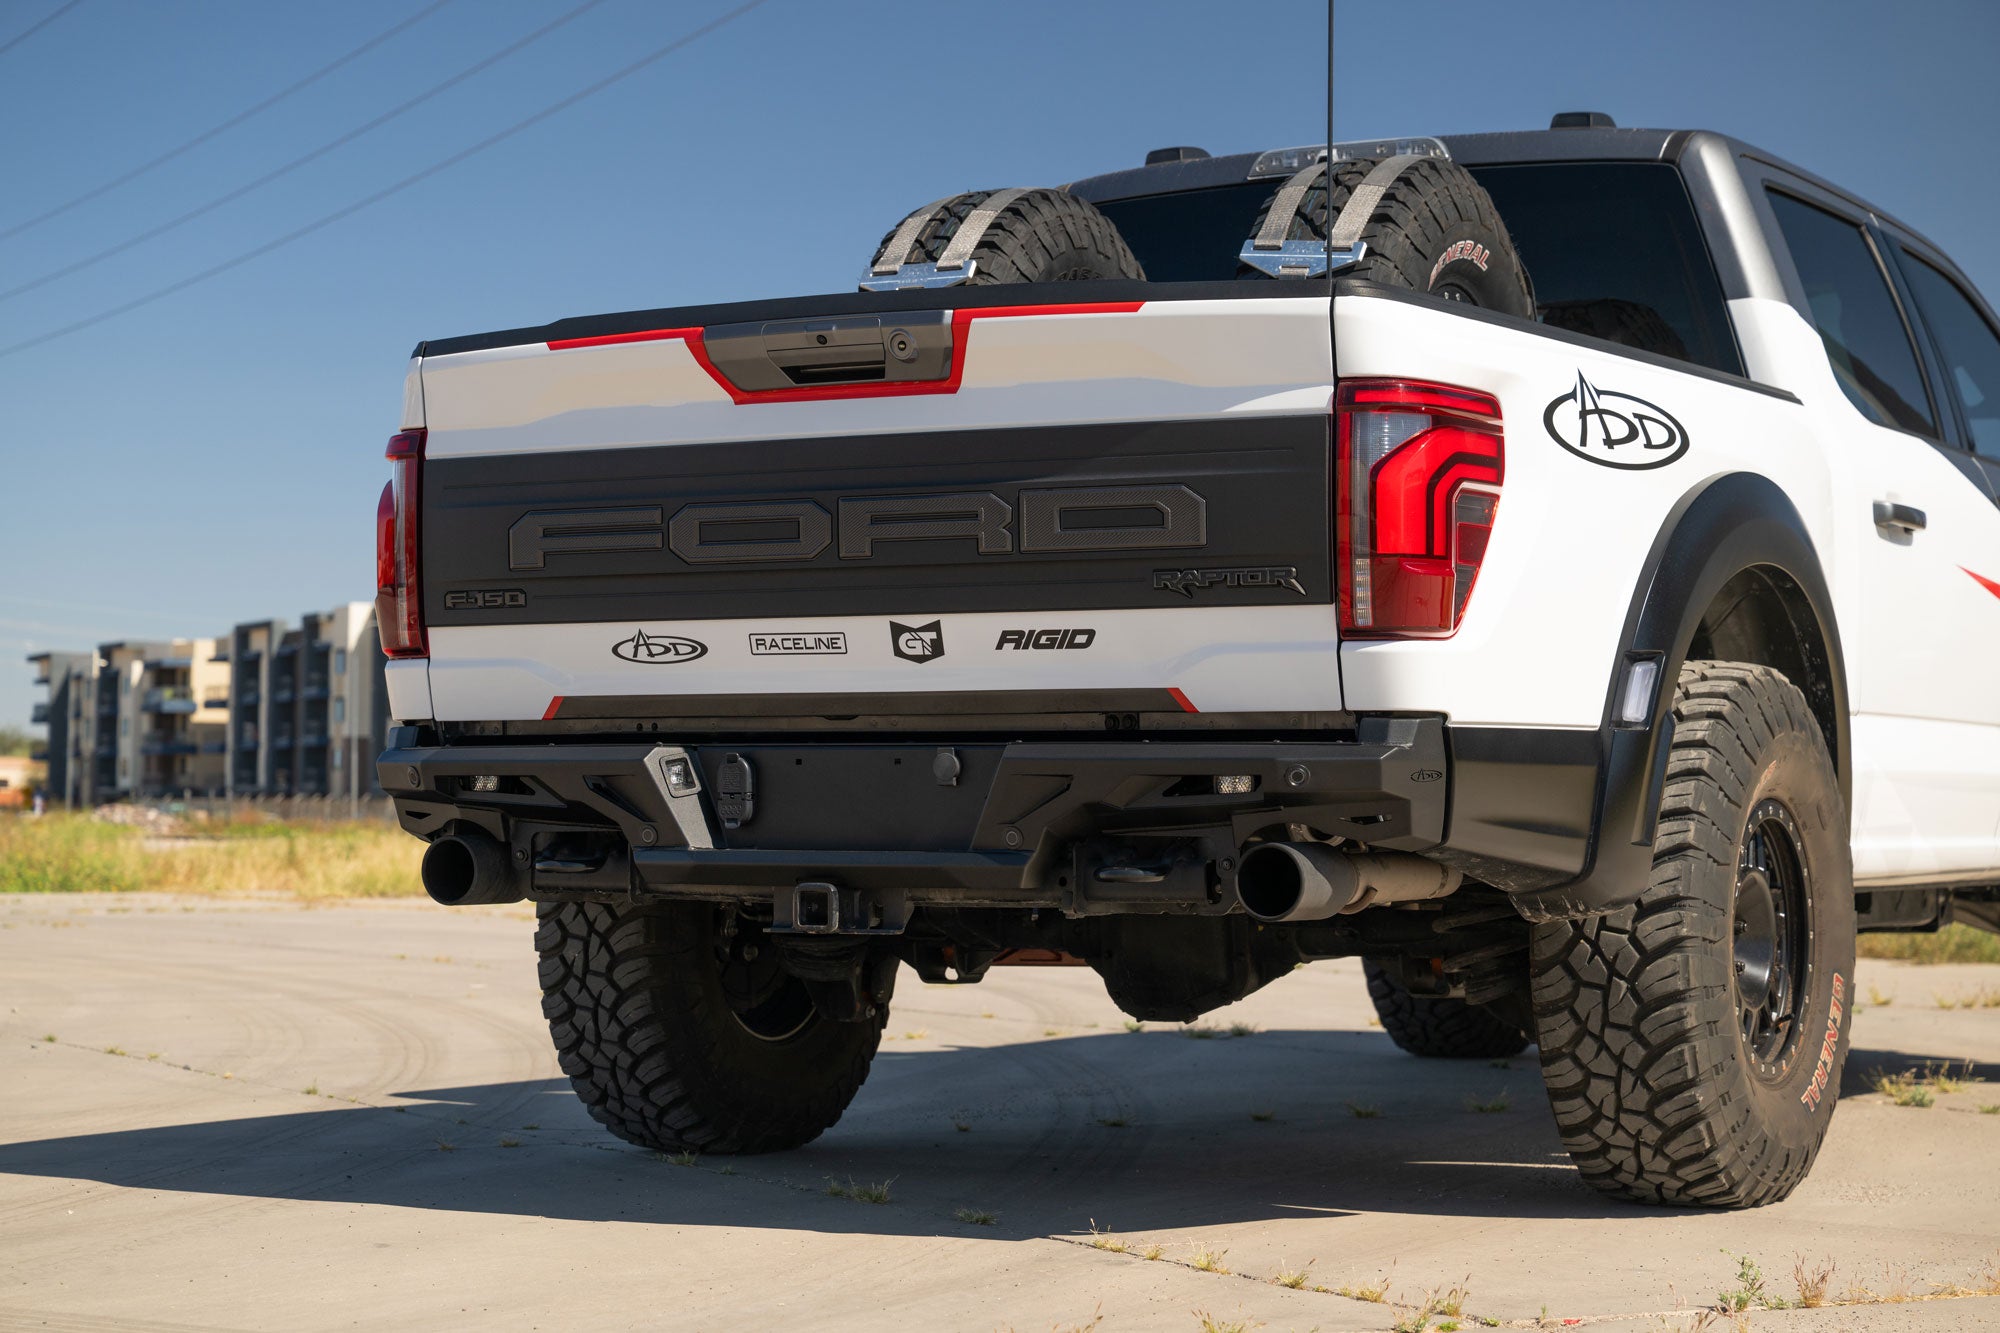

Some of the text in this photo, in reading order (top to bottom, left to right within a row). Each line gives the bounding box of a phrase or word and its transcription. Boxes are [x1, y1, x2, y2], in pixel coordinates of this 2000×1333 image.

[508, 484, 1207, 571] FORD
[1153, 566, 1306, 598] RAPTOR
[445, 591, 526, 609] F-150
[631, 628, 699, 658] ADD
[755, 637, 842, 651] RACELINE
[995, 629, 1096, 650] RIGID
[1801, 972, 1845, 1112] GENERAL
